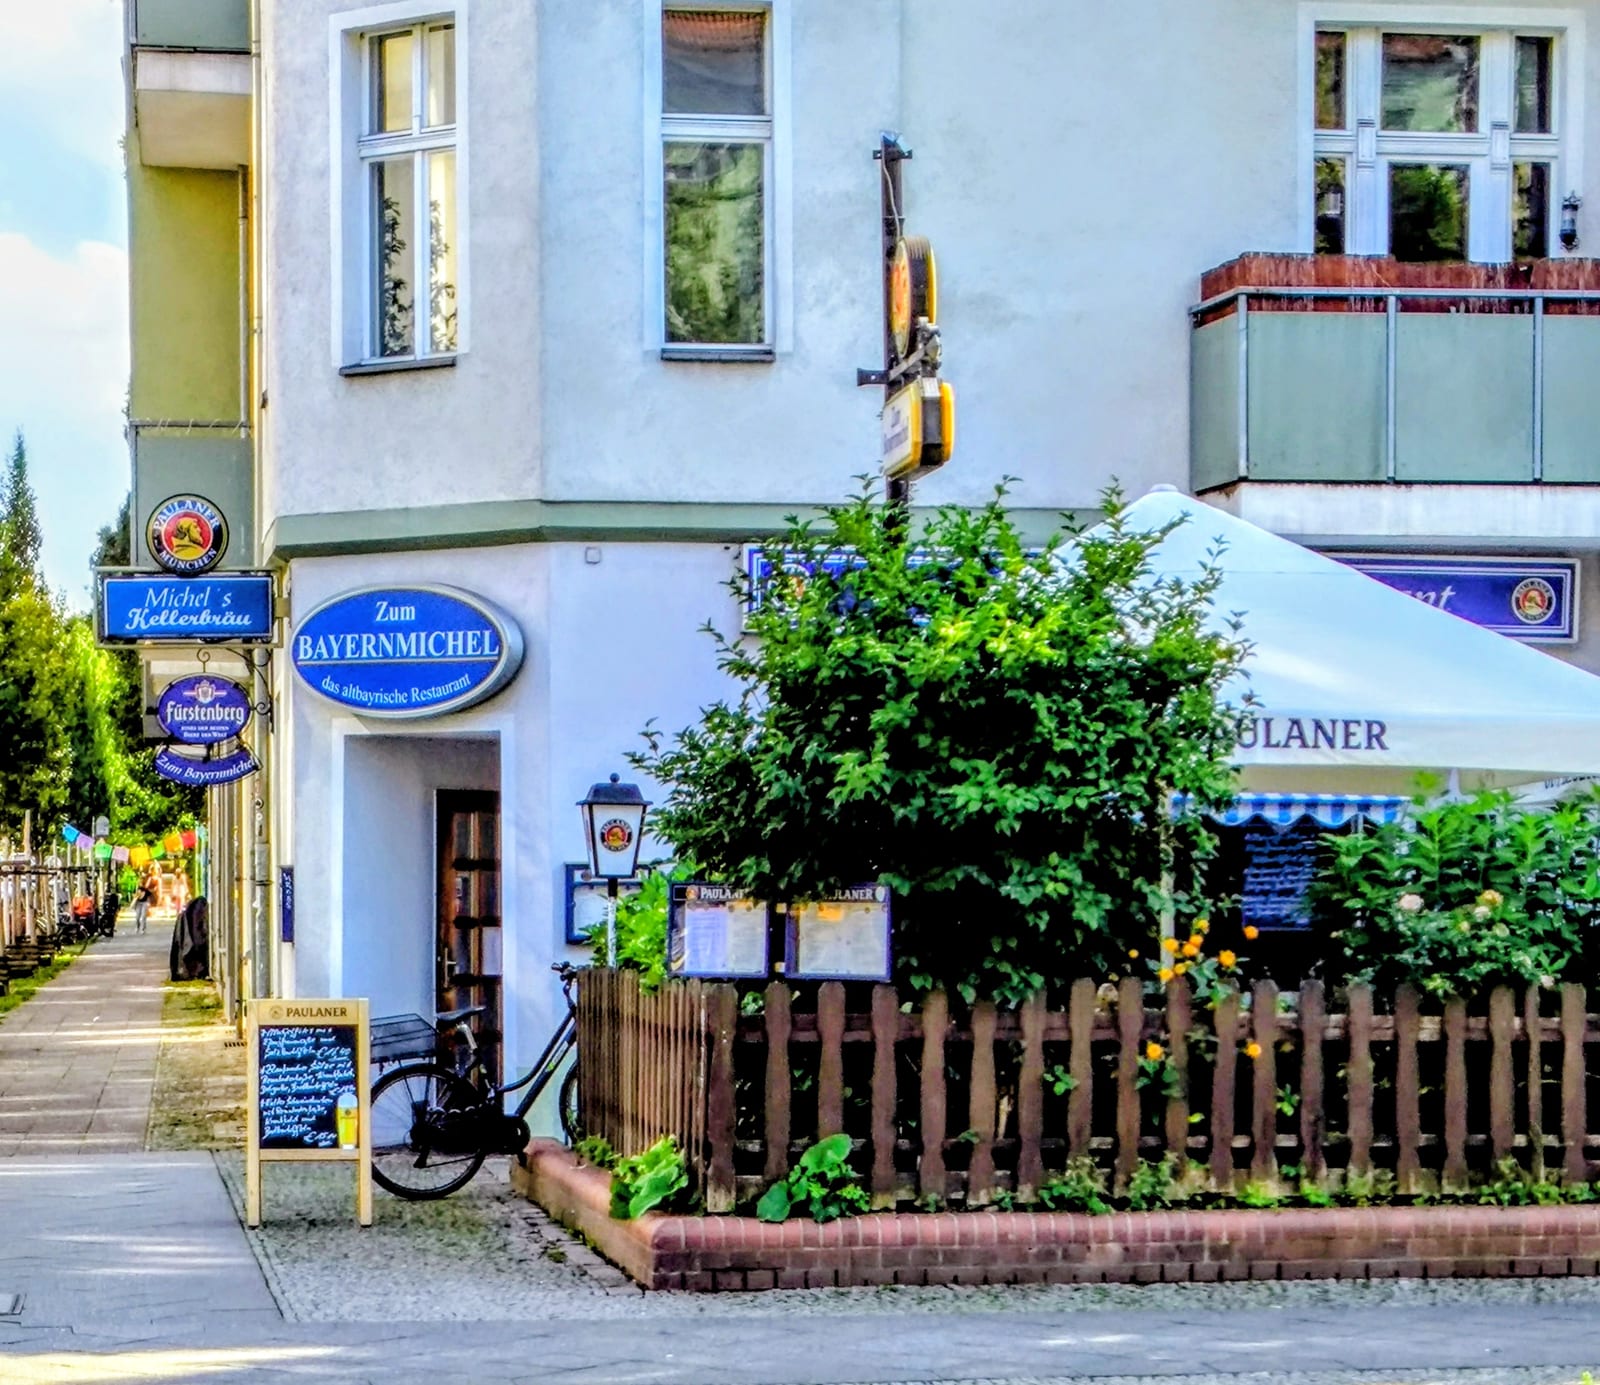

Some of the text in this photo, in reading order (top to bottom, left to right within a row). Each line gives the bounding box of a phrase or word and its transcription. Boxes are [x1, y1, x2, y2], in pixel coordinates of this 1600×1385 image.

[153, 500, 221, 530] PAULANER
[125, 607, 252, 630] Kellerbräu
[375, 601, 416, 622] Zum
[298, 630, 499, 660] BAYERNMICHEL
[322, 673, 471, 705] das altbayrische Restaurant
[166, 701, 244, 725] Fürstenberg
[1235, 717, 1390, 750] ULANER
[157, 755, 183, 775] Zum
[286, 1007, 348, 1017] PAULANER
